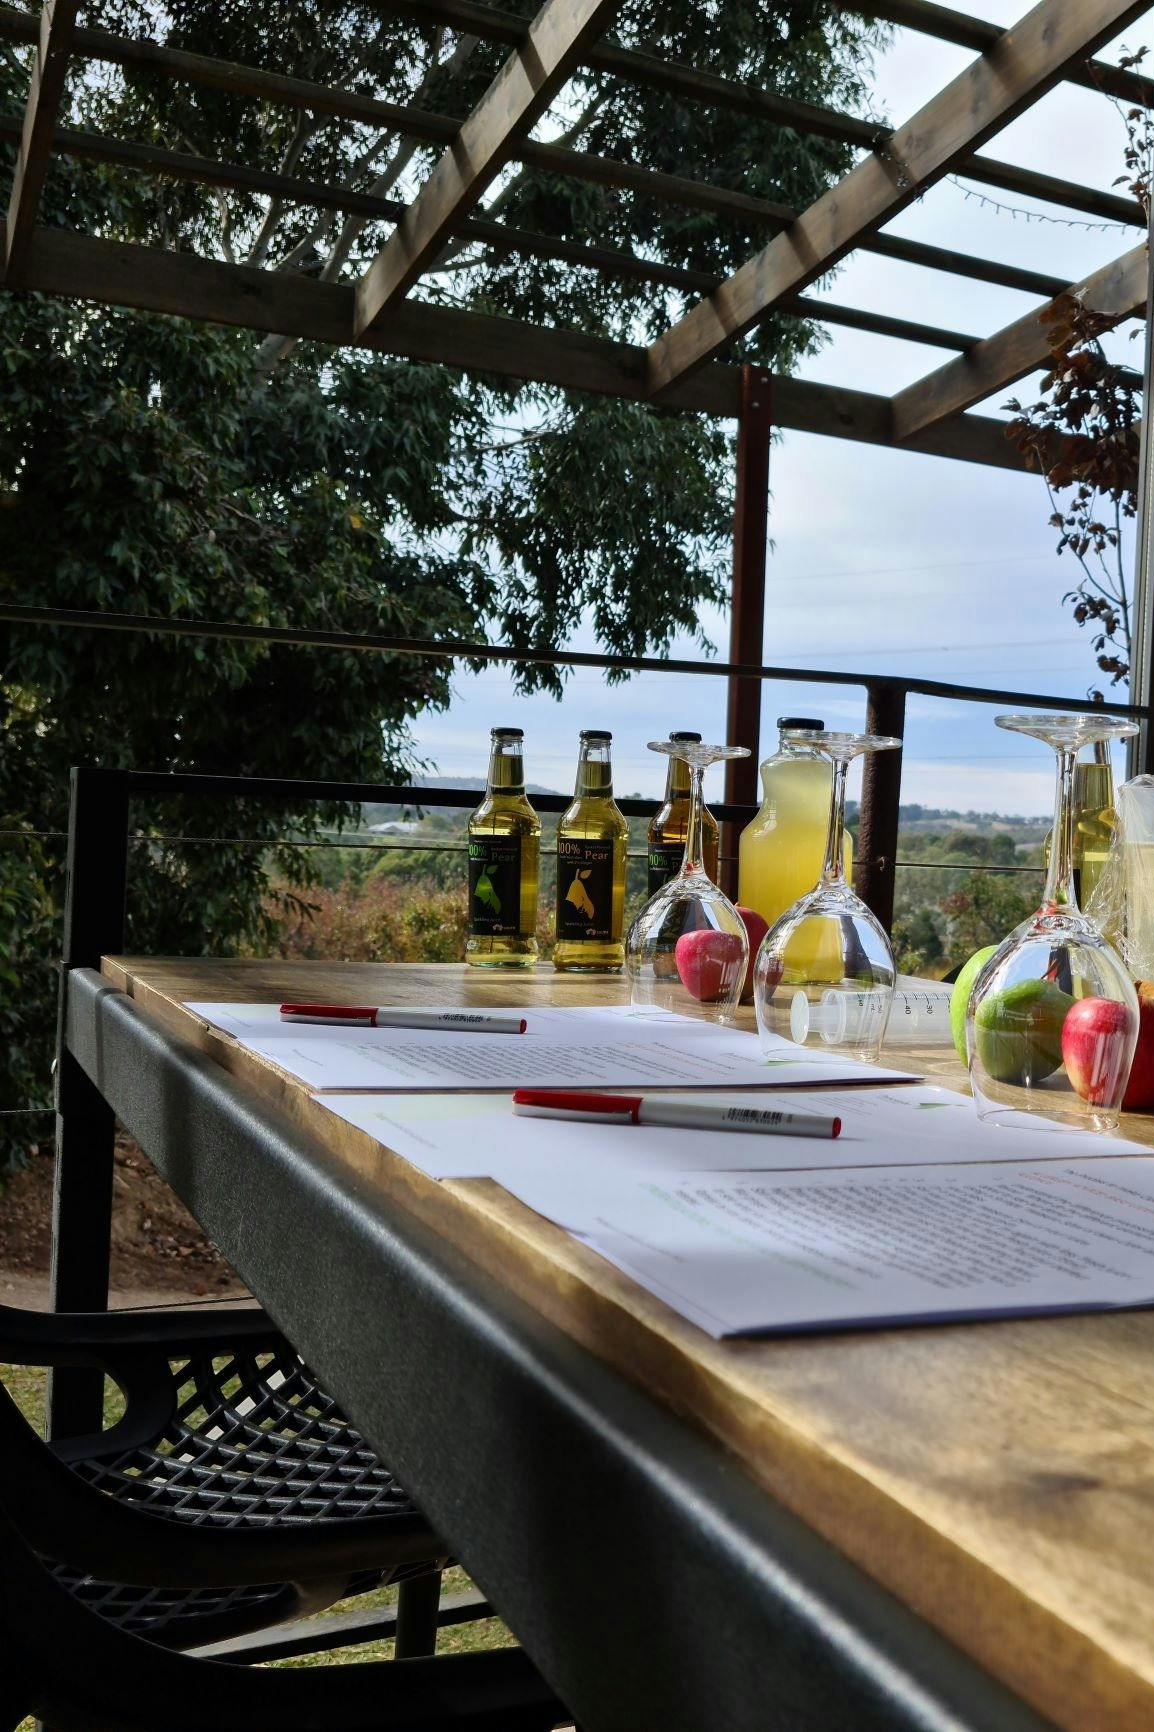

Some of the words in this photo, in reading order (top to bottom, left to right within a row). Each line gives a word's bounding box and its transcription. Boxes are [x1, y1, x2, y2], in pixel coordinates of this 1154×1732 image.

[468, 844, 487, 857] 00%
[584, 850, 609, 860] Pear
[649, 854, 668, 867] 00%
